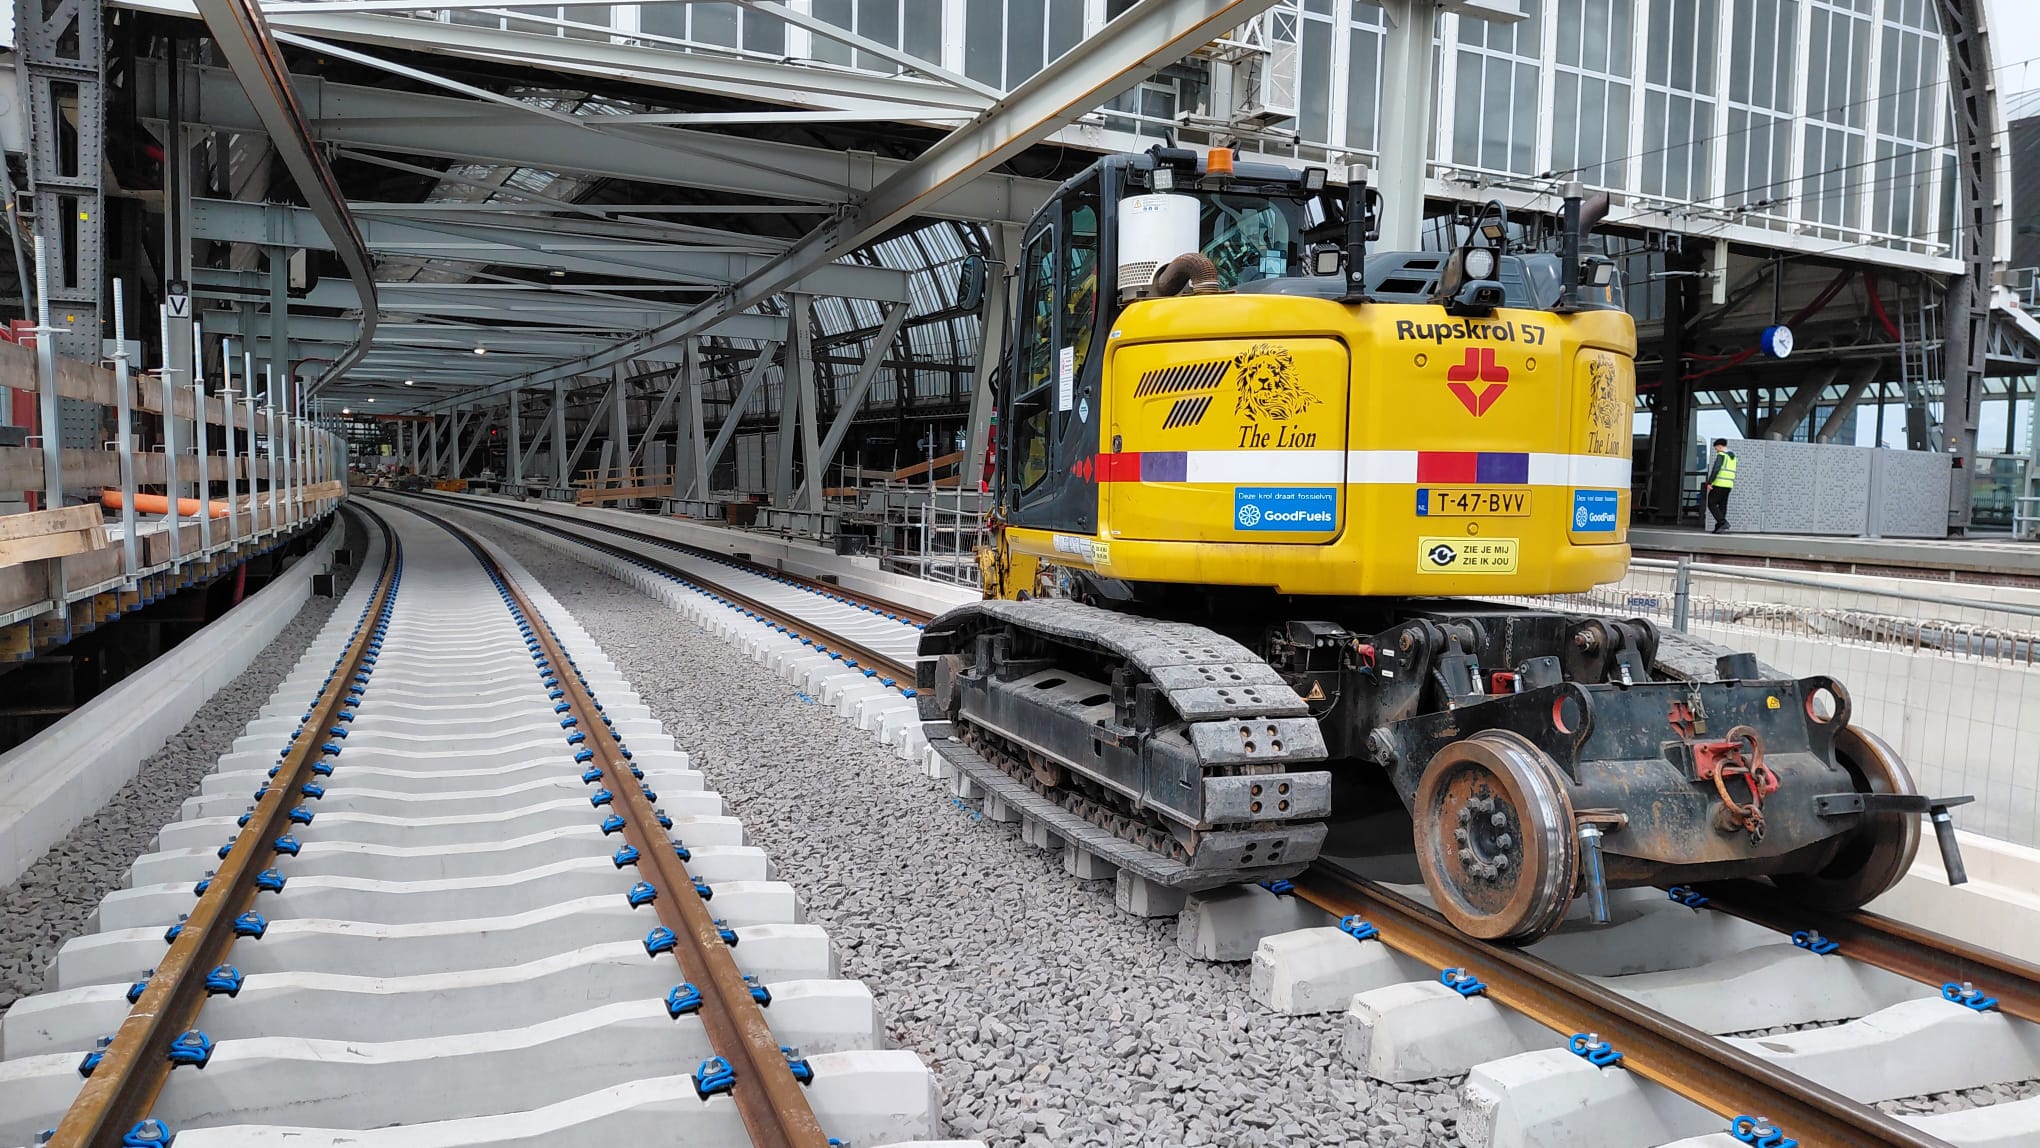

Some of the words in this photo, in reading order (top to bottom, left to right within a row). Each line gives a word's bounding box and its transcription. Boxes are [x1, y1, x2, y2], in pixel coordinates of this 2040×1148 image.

[170, 296, 187, 315] V
[1396, 320, 1516, 345] Rupskrol
[1521, 323, 1546, 346] 57
[1238, 423, 1271, 448] The
[1276, 424, 1317, 448] Lion
[1588, 431, 1604, 454] The
[1605, 433, 1620, 455] Lion
[1238, 492, 1256, 500] Deze
[1258, 492, 1273, 500] krol
[1437, 493, 1525, 513] T-47-BVV
[1264, 510, 1332, 522] GoodFuels
[1589, 511, 1616, 523] GoodFuels
[1463, 545, 1478, 554] ZIE
[1481, 545, 1492, 554] JE
[1494, 546, 1509, 554] MIJ
[1462, 557, 1478, 566] ZIE
[1480, 557, 1489, 566] IK
[1491, 557, 1509, 566] JOU
